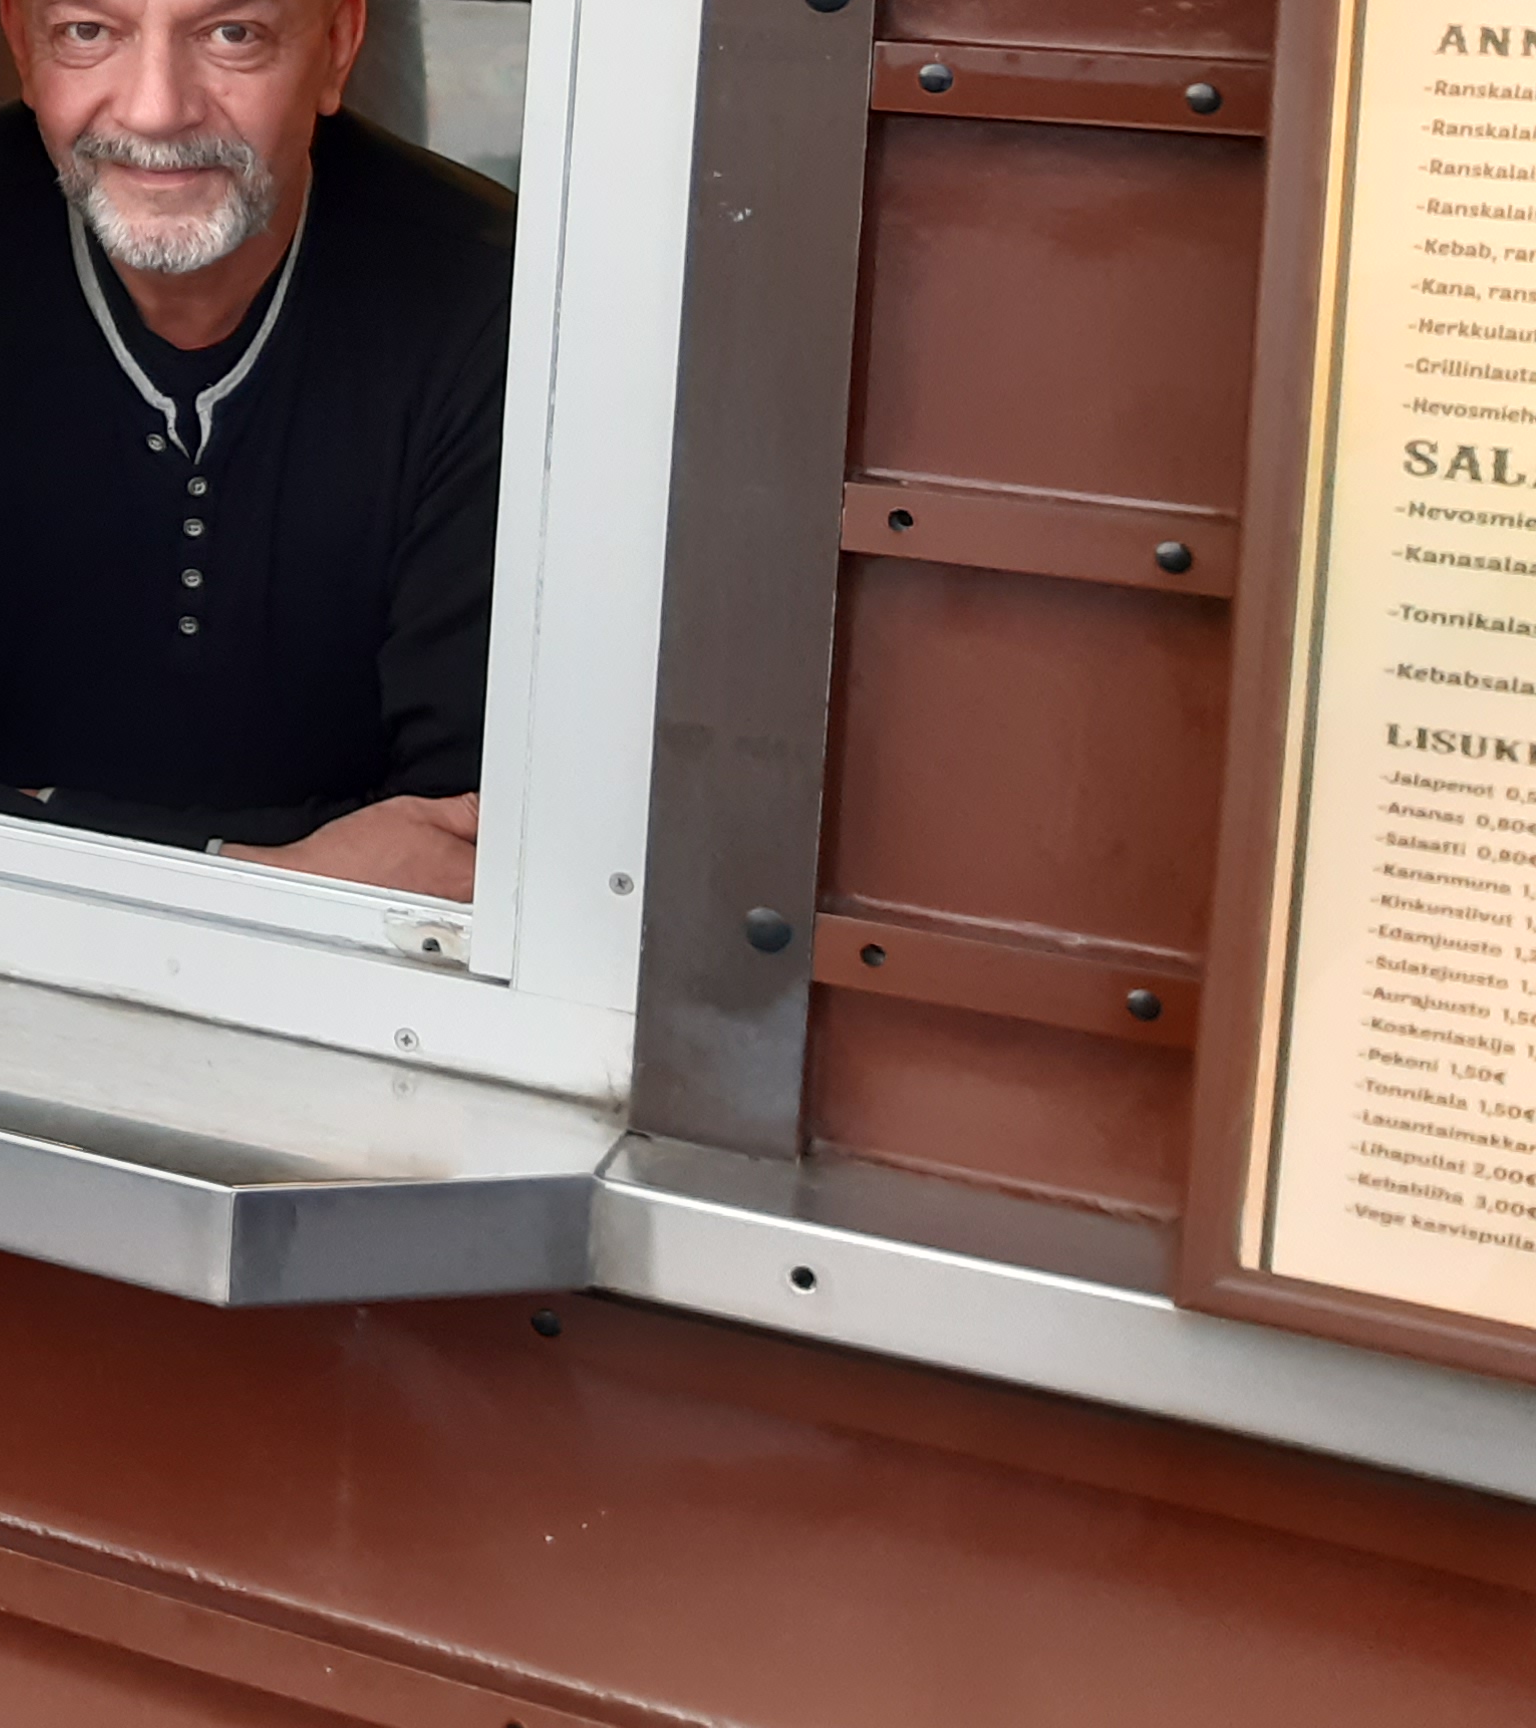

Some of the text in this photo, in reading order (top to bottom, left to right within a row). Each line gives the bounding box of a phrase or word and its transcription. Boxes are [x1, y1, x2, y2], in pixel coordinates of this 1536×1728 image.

[1423, 79, 1536, 103] -Ranskala
[1415, 197, 1536, 223] -Ranskalai
[1402, 397, 1536, 424] -Hevosmieh
[1402, 438, 1536, 489] SAL
[1383, 661, 1536, 697] -Kebabsala
